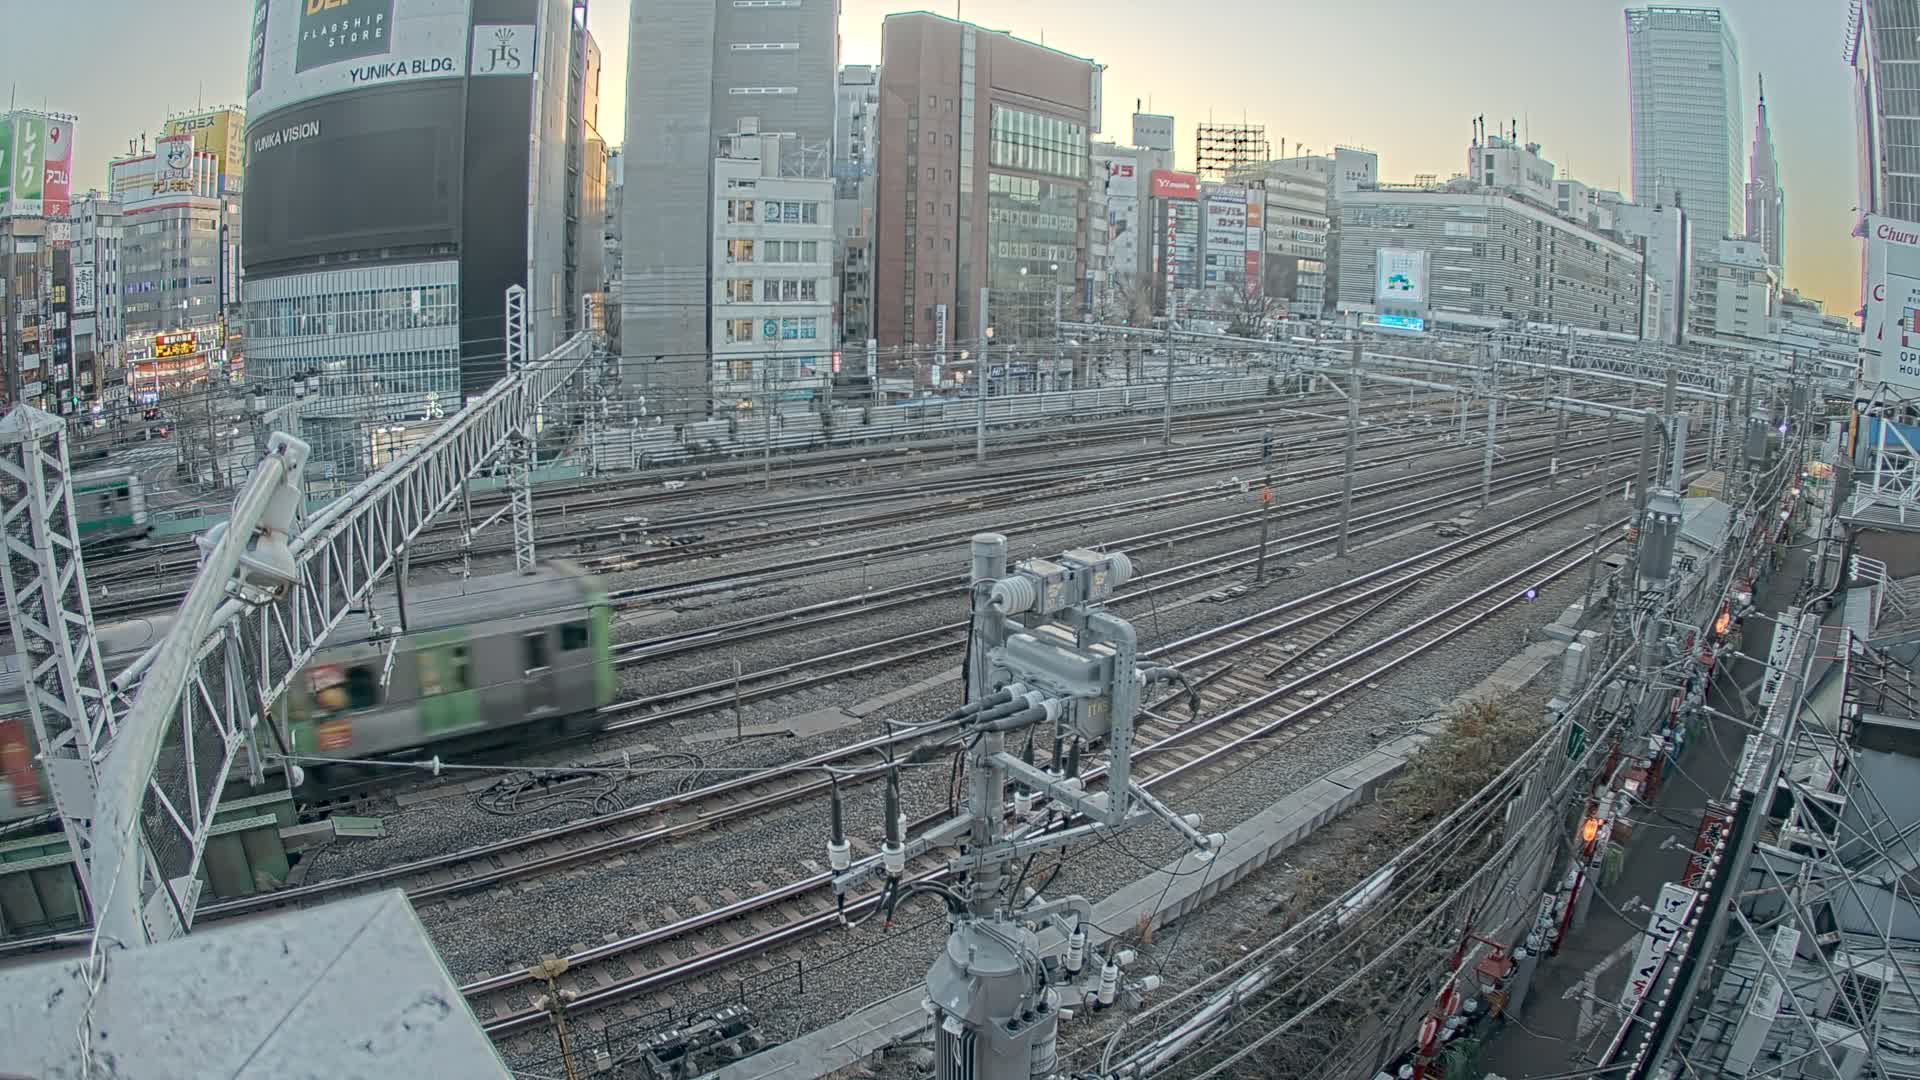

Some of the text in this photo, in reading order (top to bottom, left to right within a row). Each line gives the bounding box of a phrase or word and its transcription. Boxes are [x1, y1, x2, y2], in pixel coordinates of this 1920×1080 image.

[303, 13, 384, 41] FLAGSHIP
[328, 27, 383, 48] STORE
[349, 57, 457, 84] YUNIKA BLDG.
[479, 43, 521, 73] JIS
[254, 119, 320, 153] YUNIKA VISION
[21, 121, 37, 188] レイク
[46, 169, 69, 185] アコム
[1877, 224, 1920, 245] Churu
